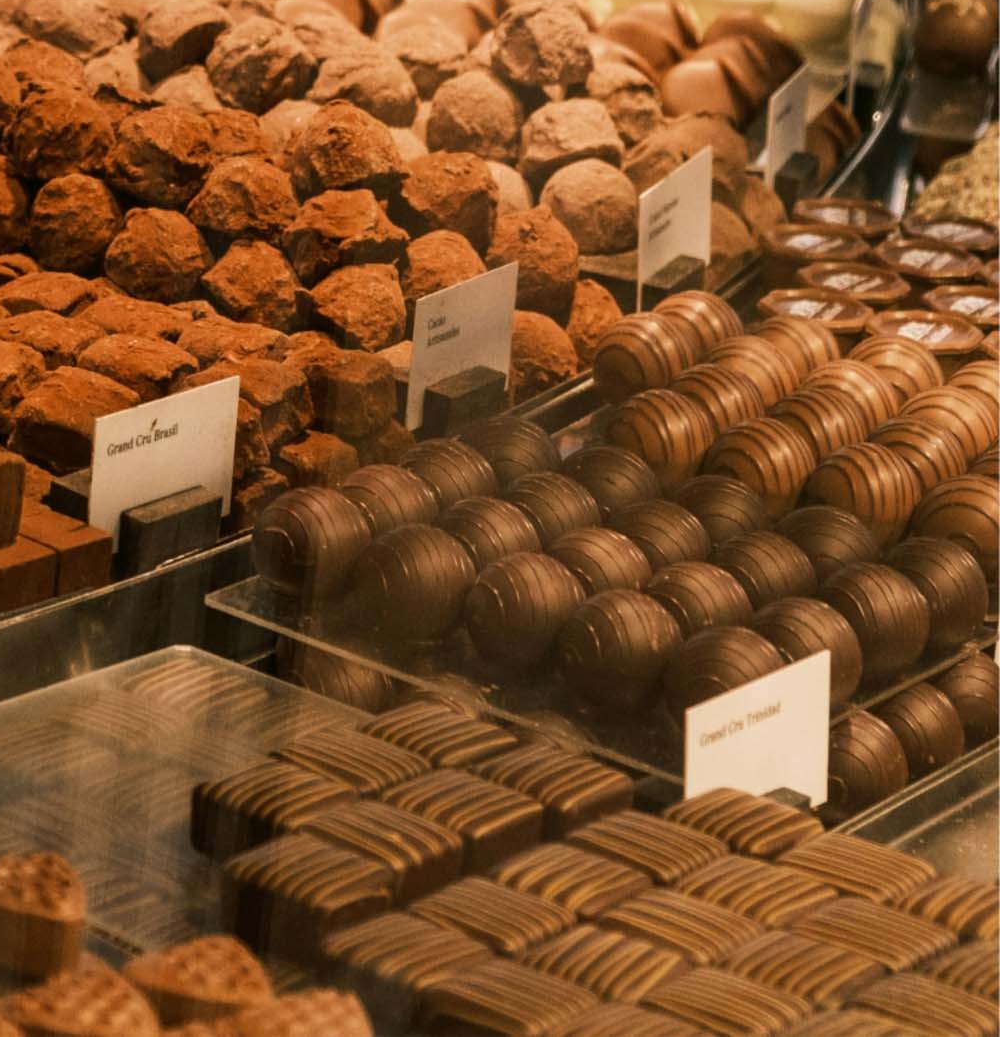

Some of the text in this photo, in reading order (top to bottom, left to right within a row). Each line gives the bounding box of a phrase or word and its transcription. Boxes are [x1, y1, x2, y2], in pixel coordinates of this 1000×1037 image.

[107, 436, 134, 456] Grand
[136, 434, 152, 447] Cru
[728, 718, 745, 737] Cru
